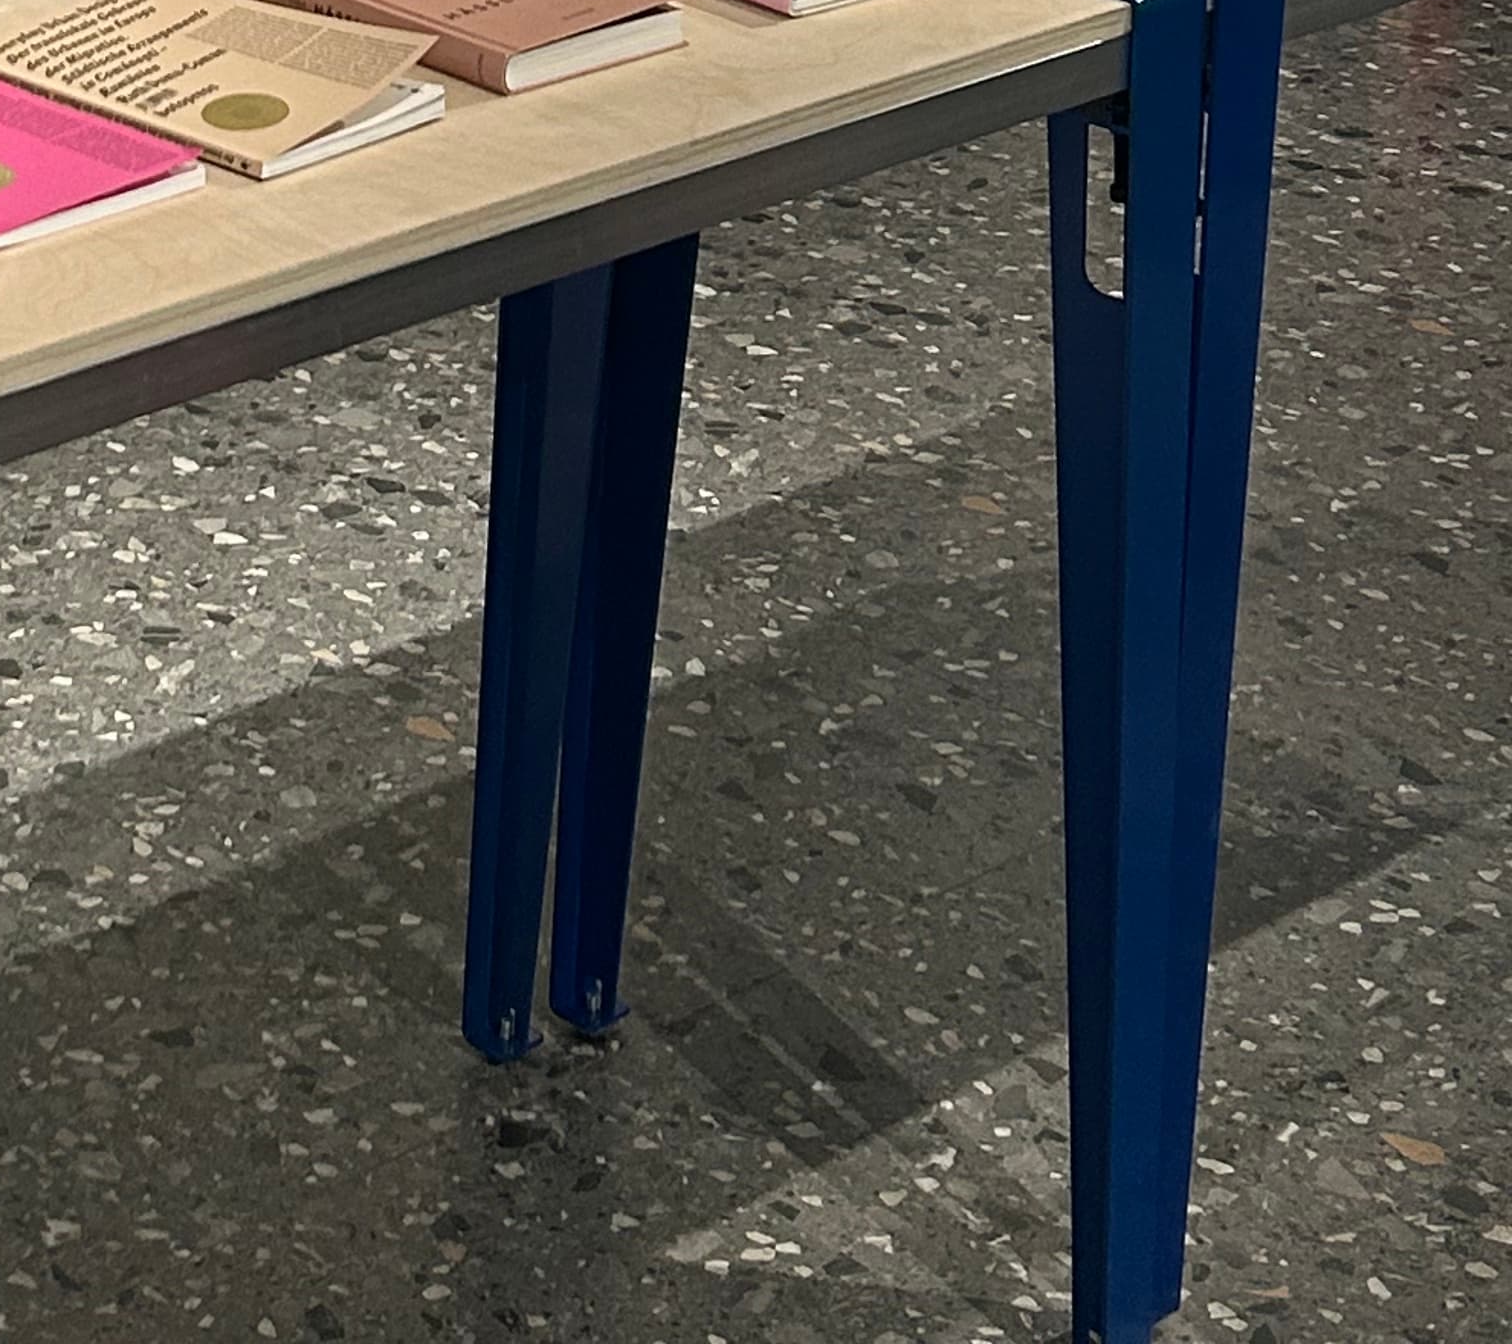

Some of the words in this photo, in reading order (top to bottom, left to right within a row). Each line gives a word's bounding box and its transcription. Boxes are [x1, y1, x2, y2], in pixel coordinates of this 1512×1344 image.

[26, 54, 50, 71] des
[114, 6, 157, 29] Europa
[126, 7, 209, 53] Arrangements
[5, 48, 29, 66] Der
[44, 60, 66, 79] der
